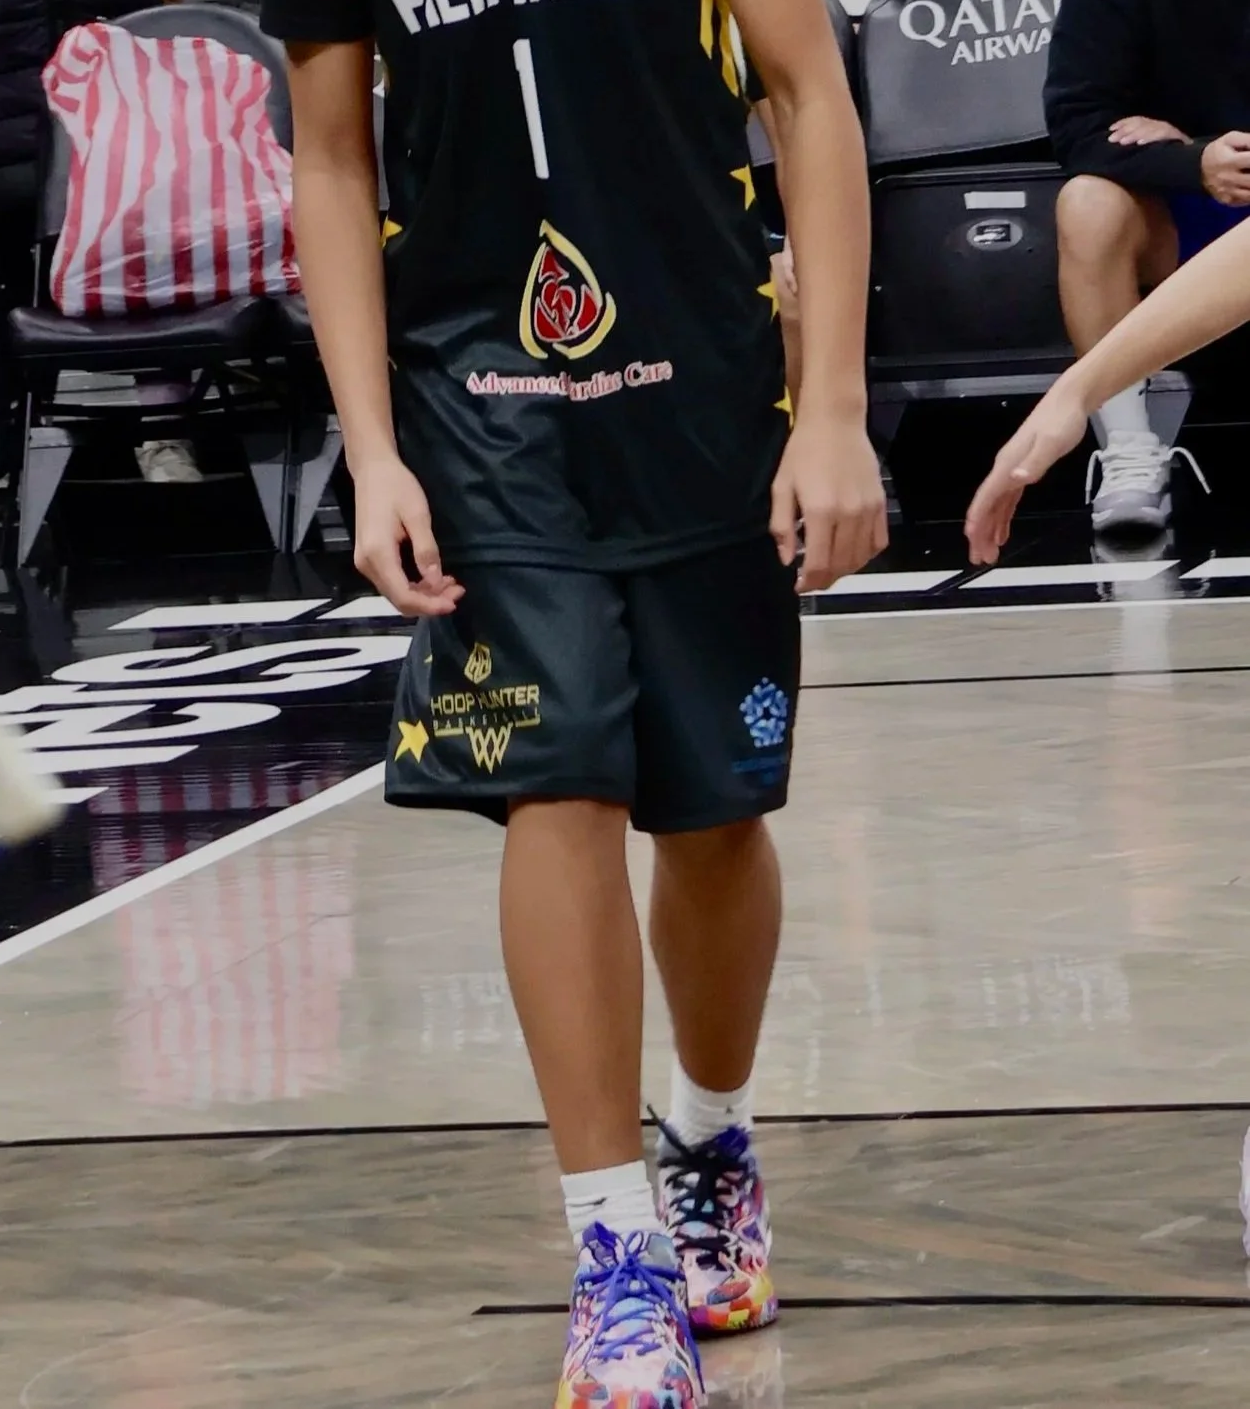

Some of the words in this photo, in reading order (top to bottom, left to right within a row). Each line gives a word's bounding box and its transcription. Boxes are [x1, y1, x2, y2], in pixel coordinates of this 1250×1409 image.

[950, 27, 1052, 66] AIRWA
[512, 38, 550, 180] 1
[623, 360, 673, 387] Care
[430, 692, 476, 715] HOOP
